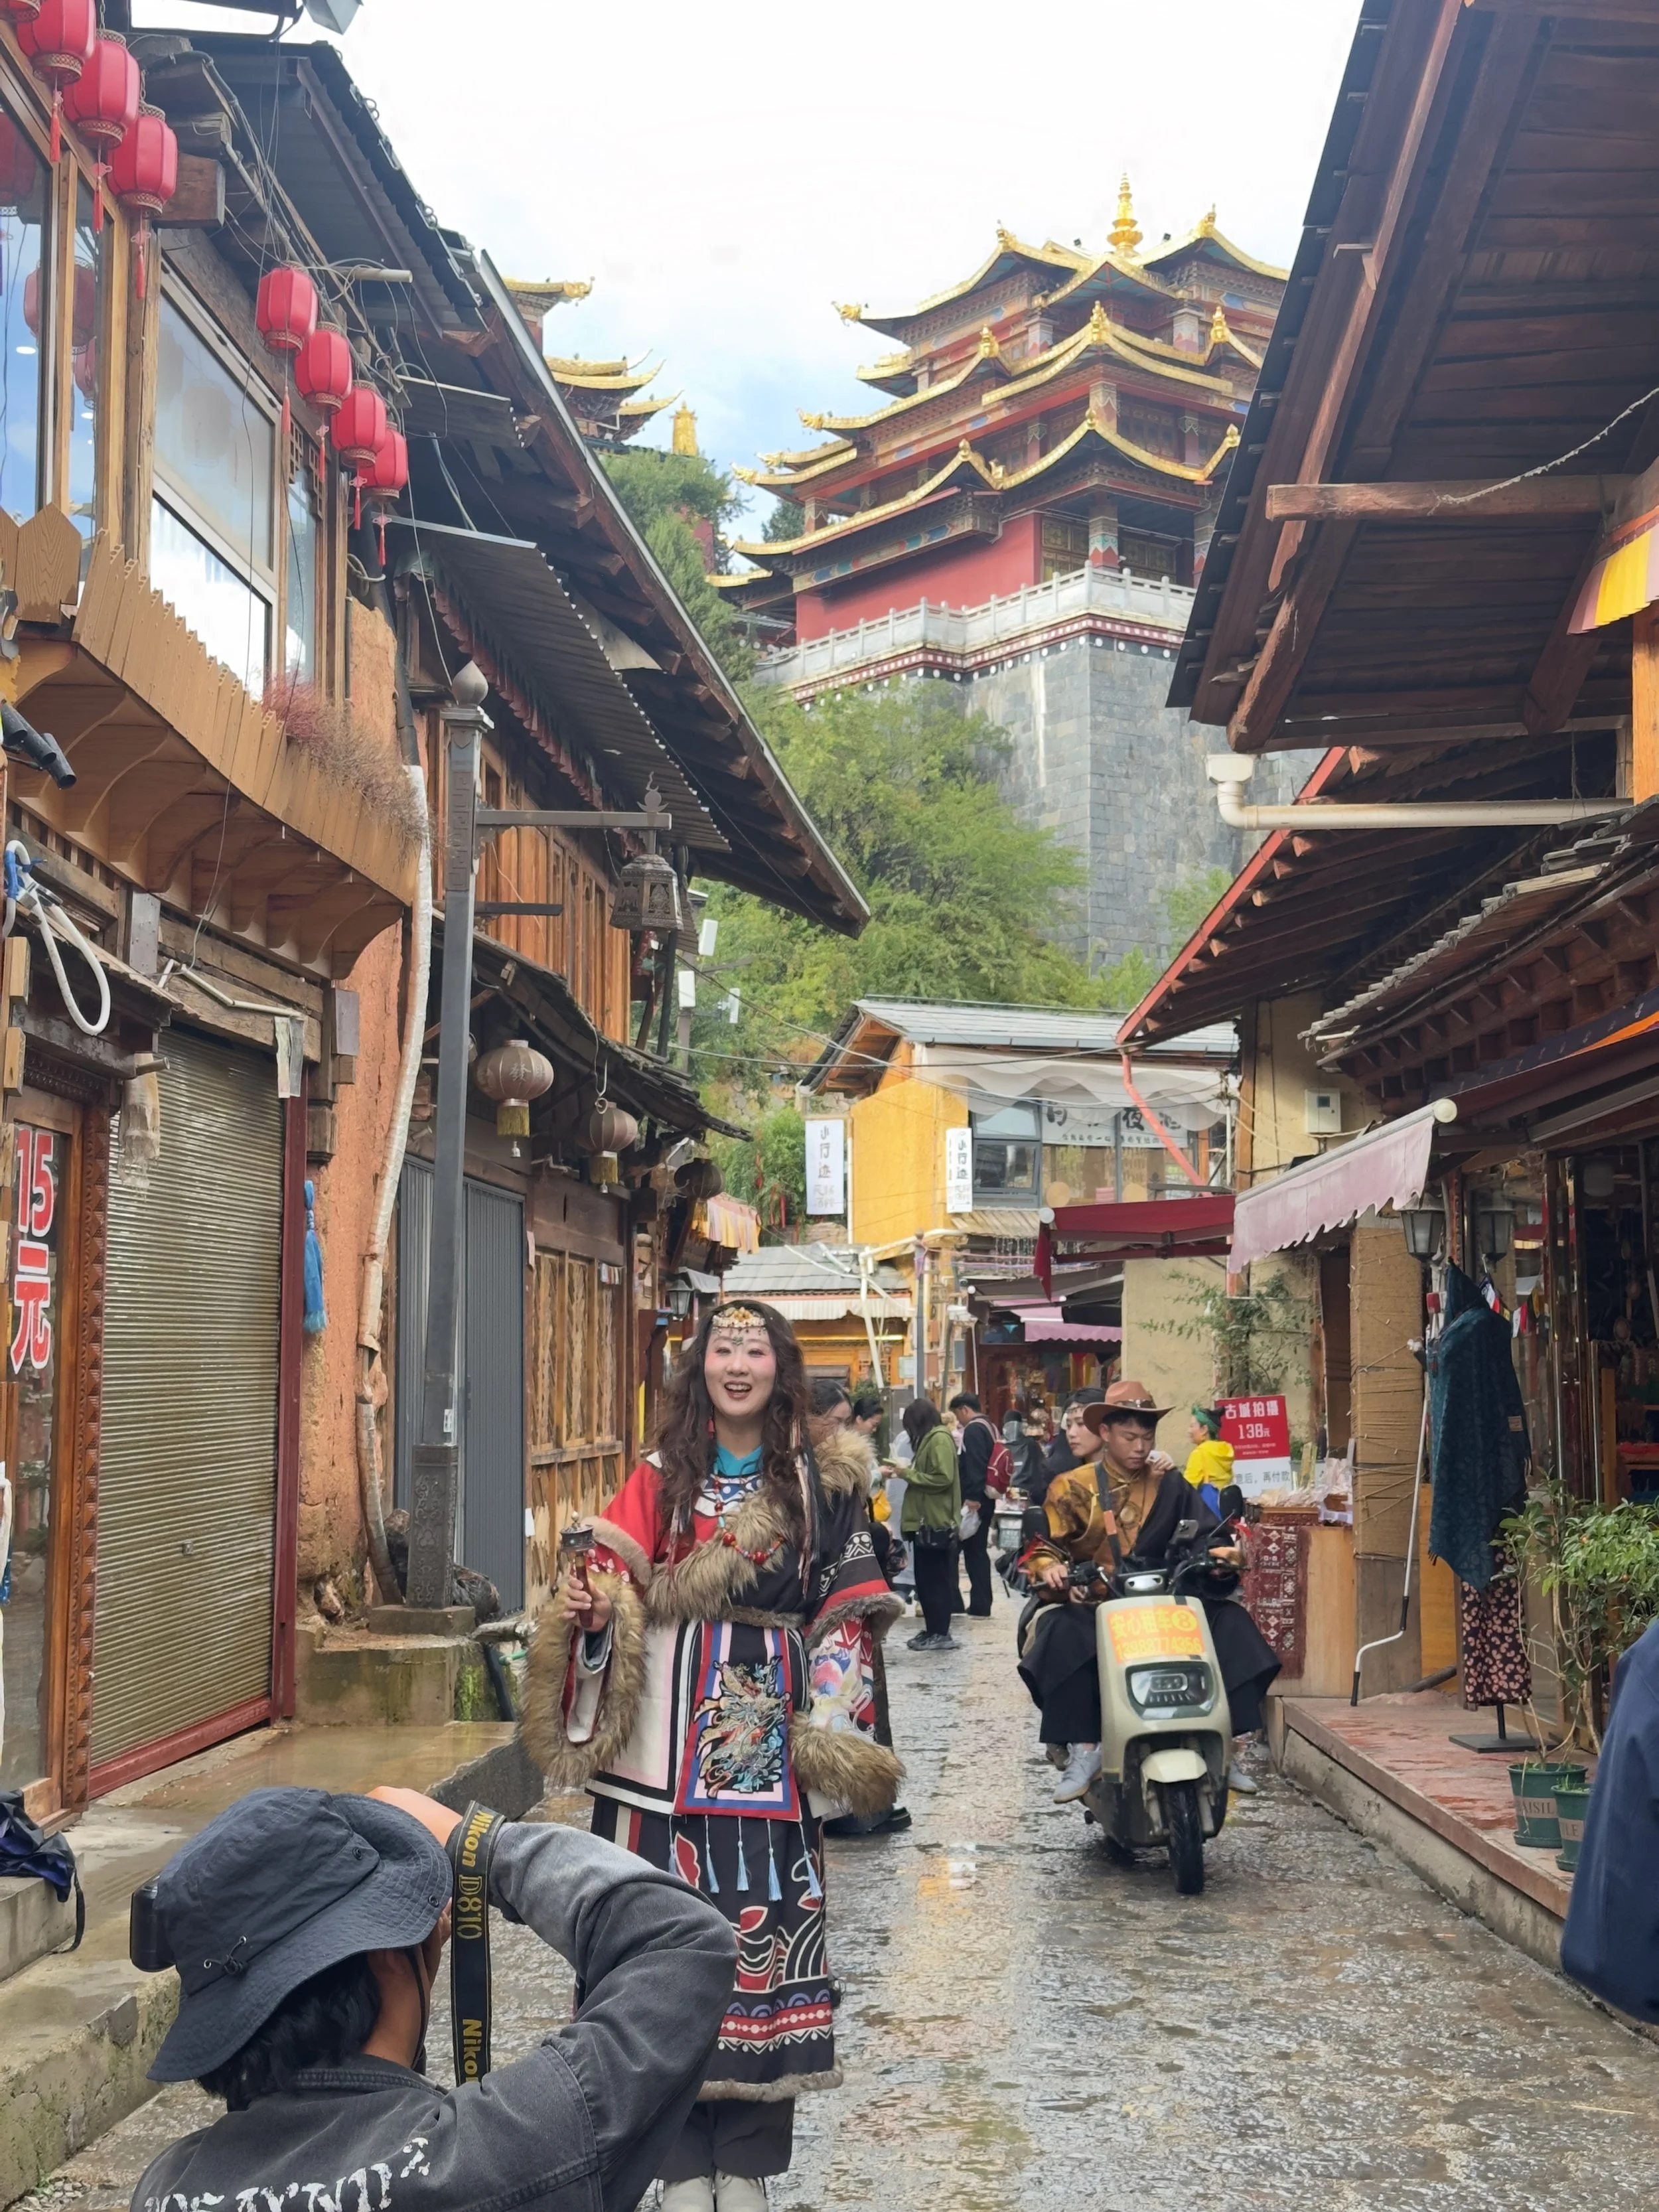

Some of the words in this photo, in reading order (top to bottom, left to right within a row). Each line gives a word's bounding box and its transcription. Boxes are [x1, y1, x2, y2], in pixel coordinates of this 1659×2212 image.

[1238, 1423, 1270, 1439] 138元
[461, 1809, 494, 1867] Nikon
[457, 1874, 482, 1939] D810
